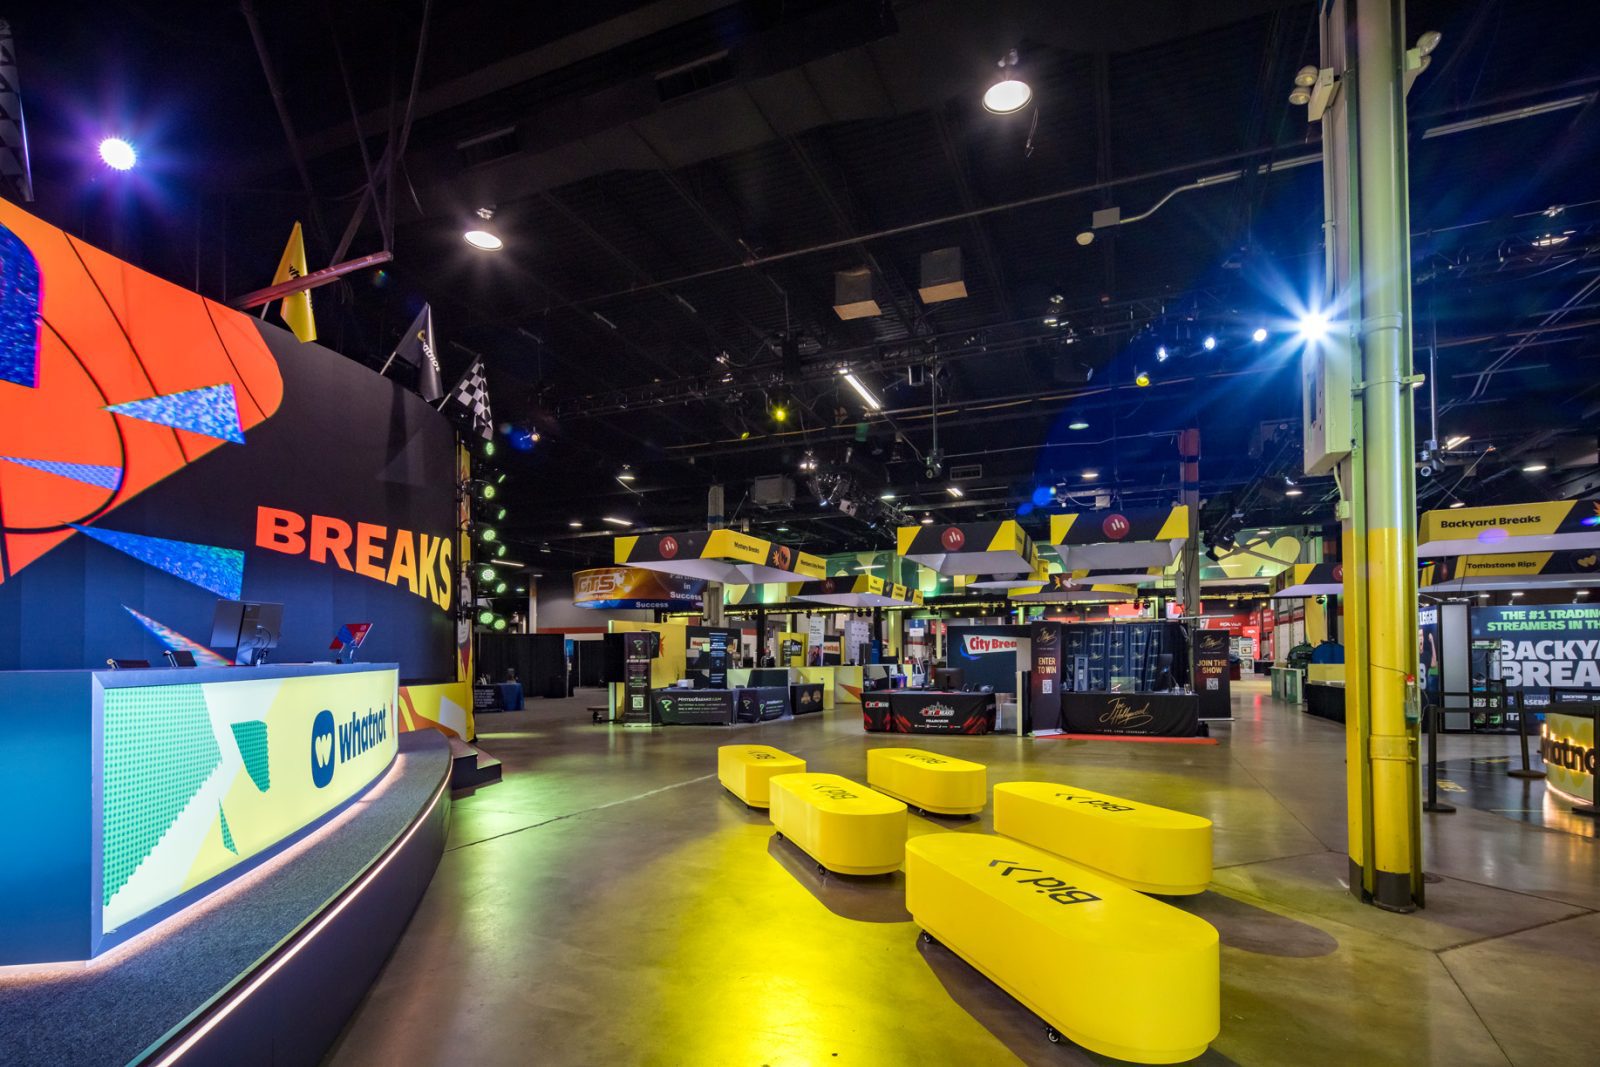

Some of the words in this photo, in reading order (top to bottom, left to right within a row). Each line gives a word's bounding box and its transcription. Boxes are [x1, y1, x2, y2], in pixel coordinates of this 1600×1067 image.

[1440, 518, 1496, 528] Backyard
[1499, 515, 1541, 525] Breaks
[256, 506, 452, 611] BREAKS
[1467, 561, 1516, 569] Tombstone
[670, 591, 702, 600] Success
[1501, 611, 1527, 620] THE
[1529, 610, 1546, 619] #1
[1487, 620, 1566, 631] STREAMERS
[1568, 620, 1583, 629] IN
[970, 636, 990, 651] City
[1501, 640, 1600, 660] BACKY
[1038, 657, 1056, 665] ENTER
[1038, 666, 1045, 674] TO
[1046, 666, 1057, 674] WIN
[338, 703, 387, 765] whatnot
[1078, 800, 1137, 812] Bid
[1016, 877, 1104, 905] Bid
